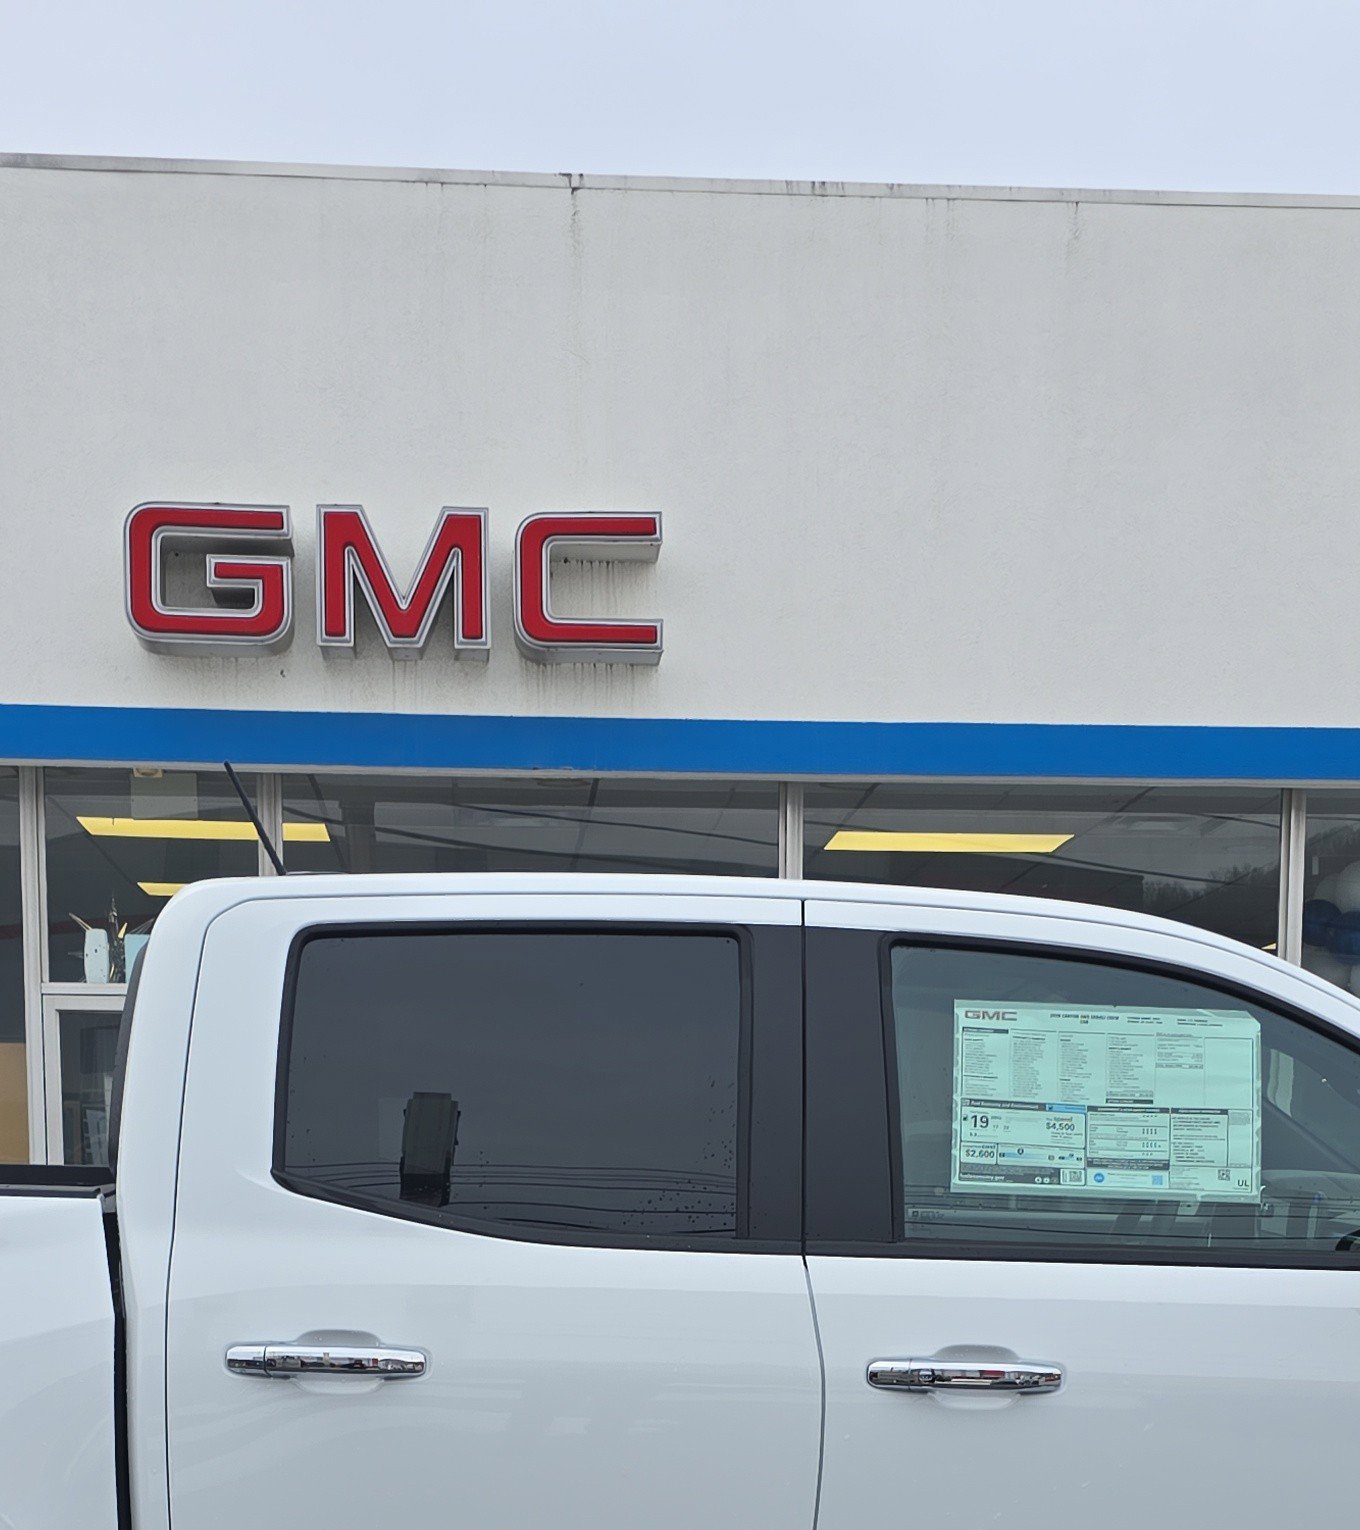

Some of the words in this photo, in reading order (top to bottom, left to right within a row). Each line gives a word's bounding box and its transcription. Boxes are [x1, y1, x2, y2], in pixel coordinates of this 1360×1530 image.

[124, 501, 663, 660] GMC
[964, 1010, 1018, 1021] GMC
[971, 1115, 989, 1128] 19
[1046, 1122, 1075, 1131] $4,500
[965, 1149, 995, 1158] $2,600
[1237, 1179, 1249, 1187] UL
